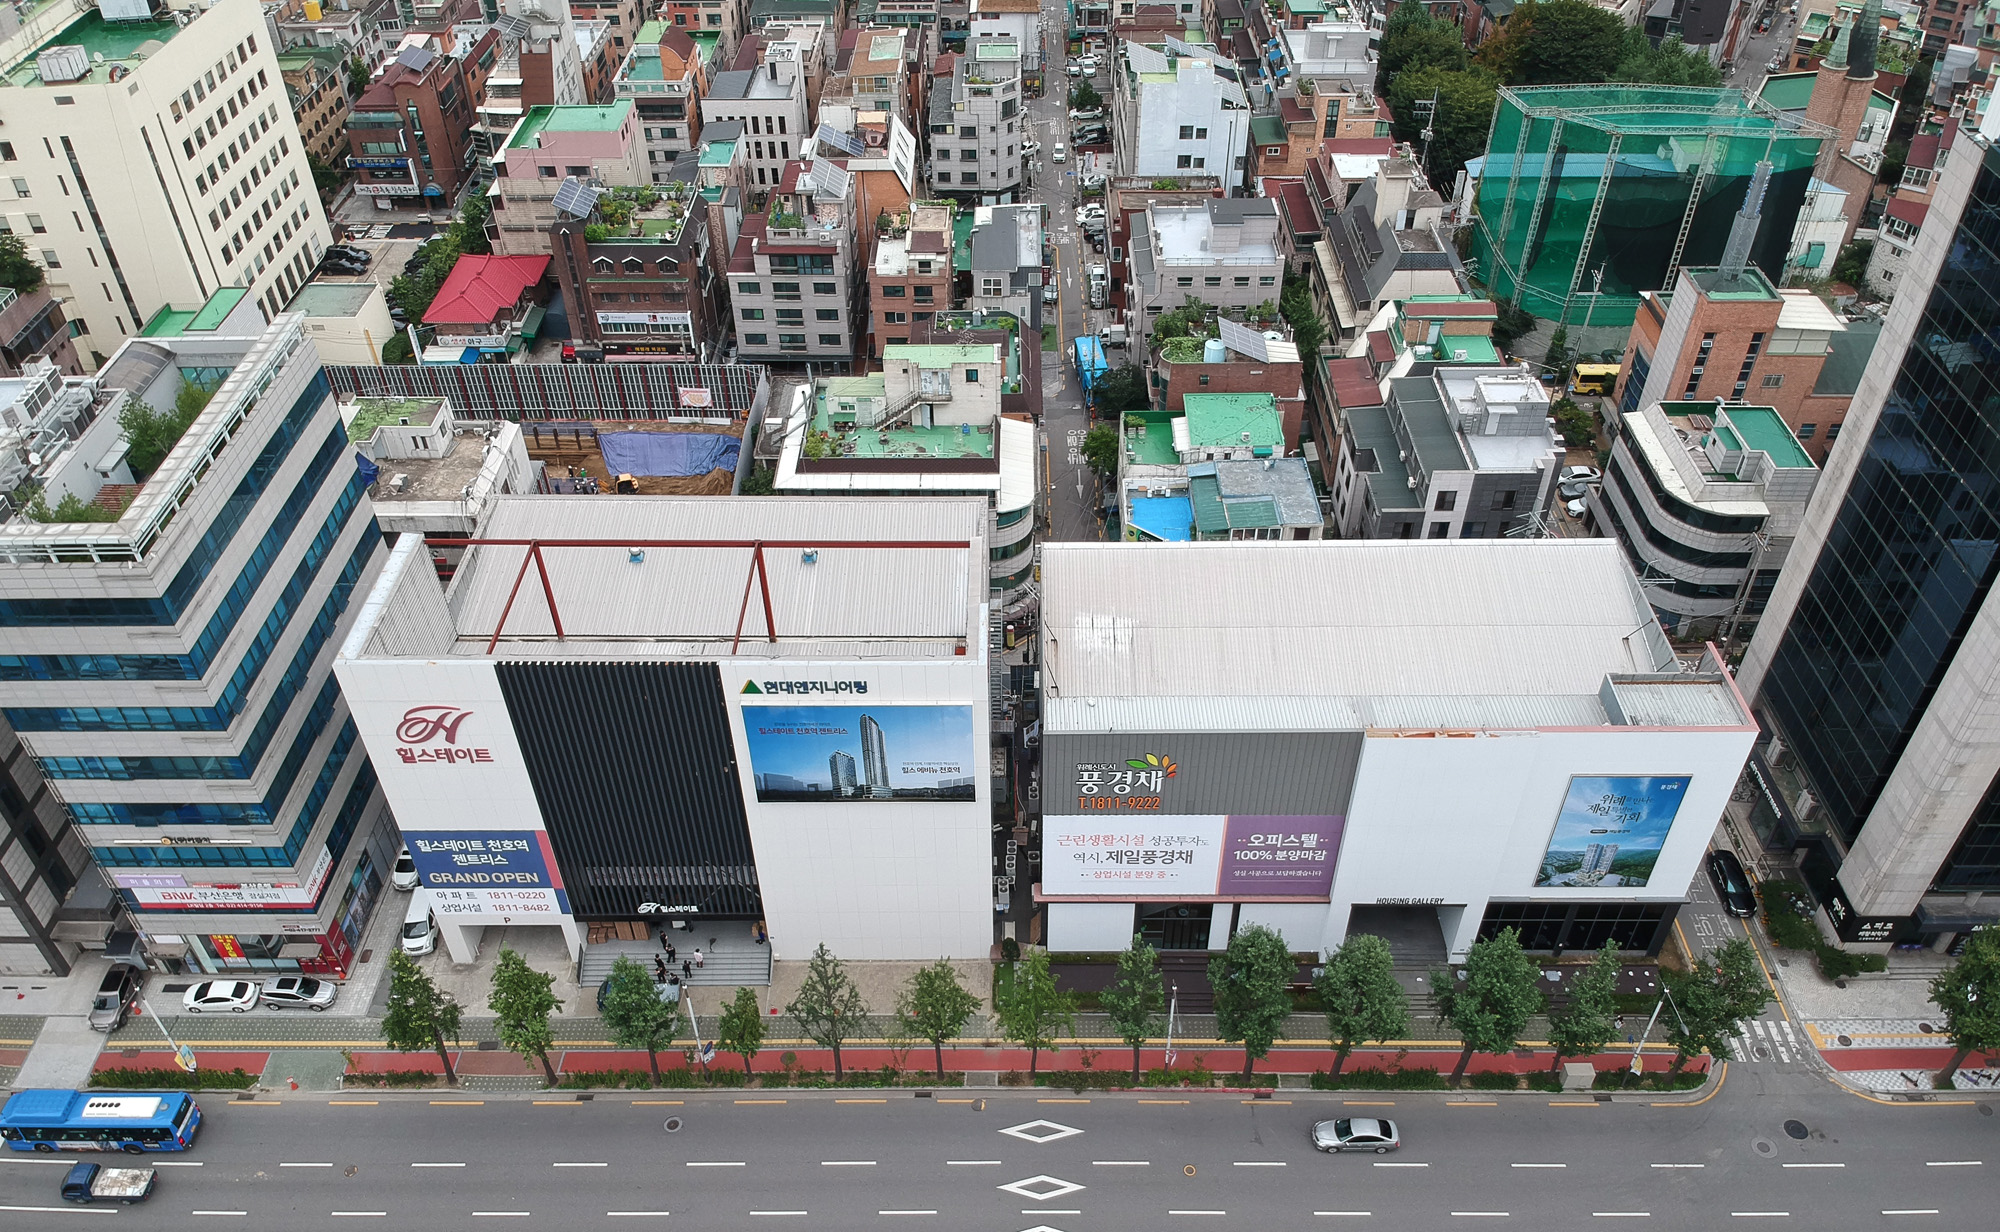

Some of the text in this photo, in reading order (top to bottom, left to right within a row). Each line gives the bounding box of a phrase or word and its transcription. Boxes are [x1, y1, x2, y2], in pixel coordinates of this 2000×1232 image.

[763, 681, 868, 694] 현대엔지니어링
[758, 727, 848, 735] 힐스테이트 천호역 젠트리스
[395, 747, 494, 763] 힐스테이트
[902, 766, 961, 774] 힐스 에비뉴 천호역
[1076, 770, 1164, 795] 풍경채
[1078, 796, 1161, 810] T.1811-9222
[1613, 812, 1641, 824] 기회
[415, 839, 530, 852] 힐스테이트 천호역
[1057, 834, 1210, 847] 근린생활시설 성공투자도
[1247, 833, 1319, 848] 오피스텔
[451, 854, 509, 866] 젠트리스
[1073, 849, 1194, 865] 역시, 제일풍경채
[1233, 850, 1328, 861] 100% 분양마감
[429, 872, 540, 884] GRAND OPEN
[1093, 870, 1167, 879] 상업시설 분양 중
[161, 892, 198, 900] BNK
[198, 892, 244, 900] 부산은행
[487, 891, 546, 900] 1811-0220
[441, 903, 551, 912] 상업시설 1811-8482
[660, 905, 699, 913] 힐스테이트
